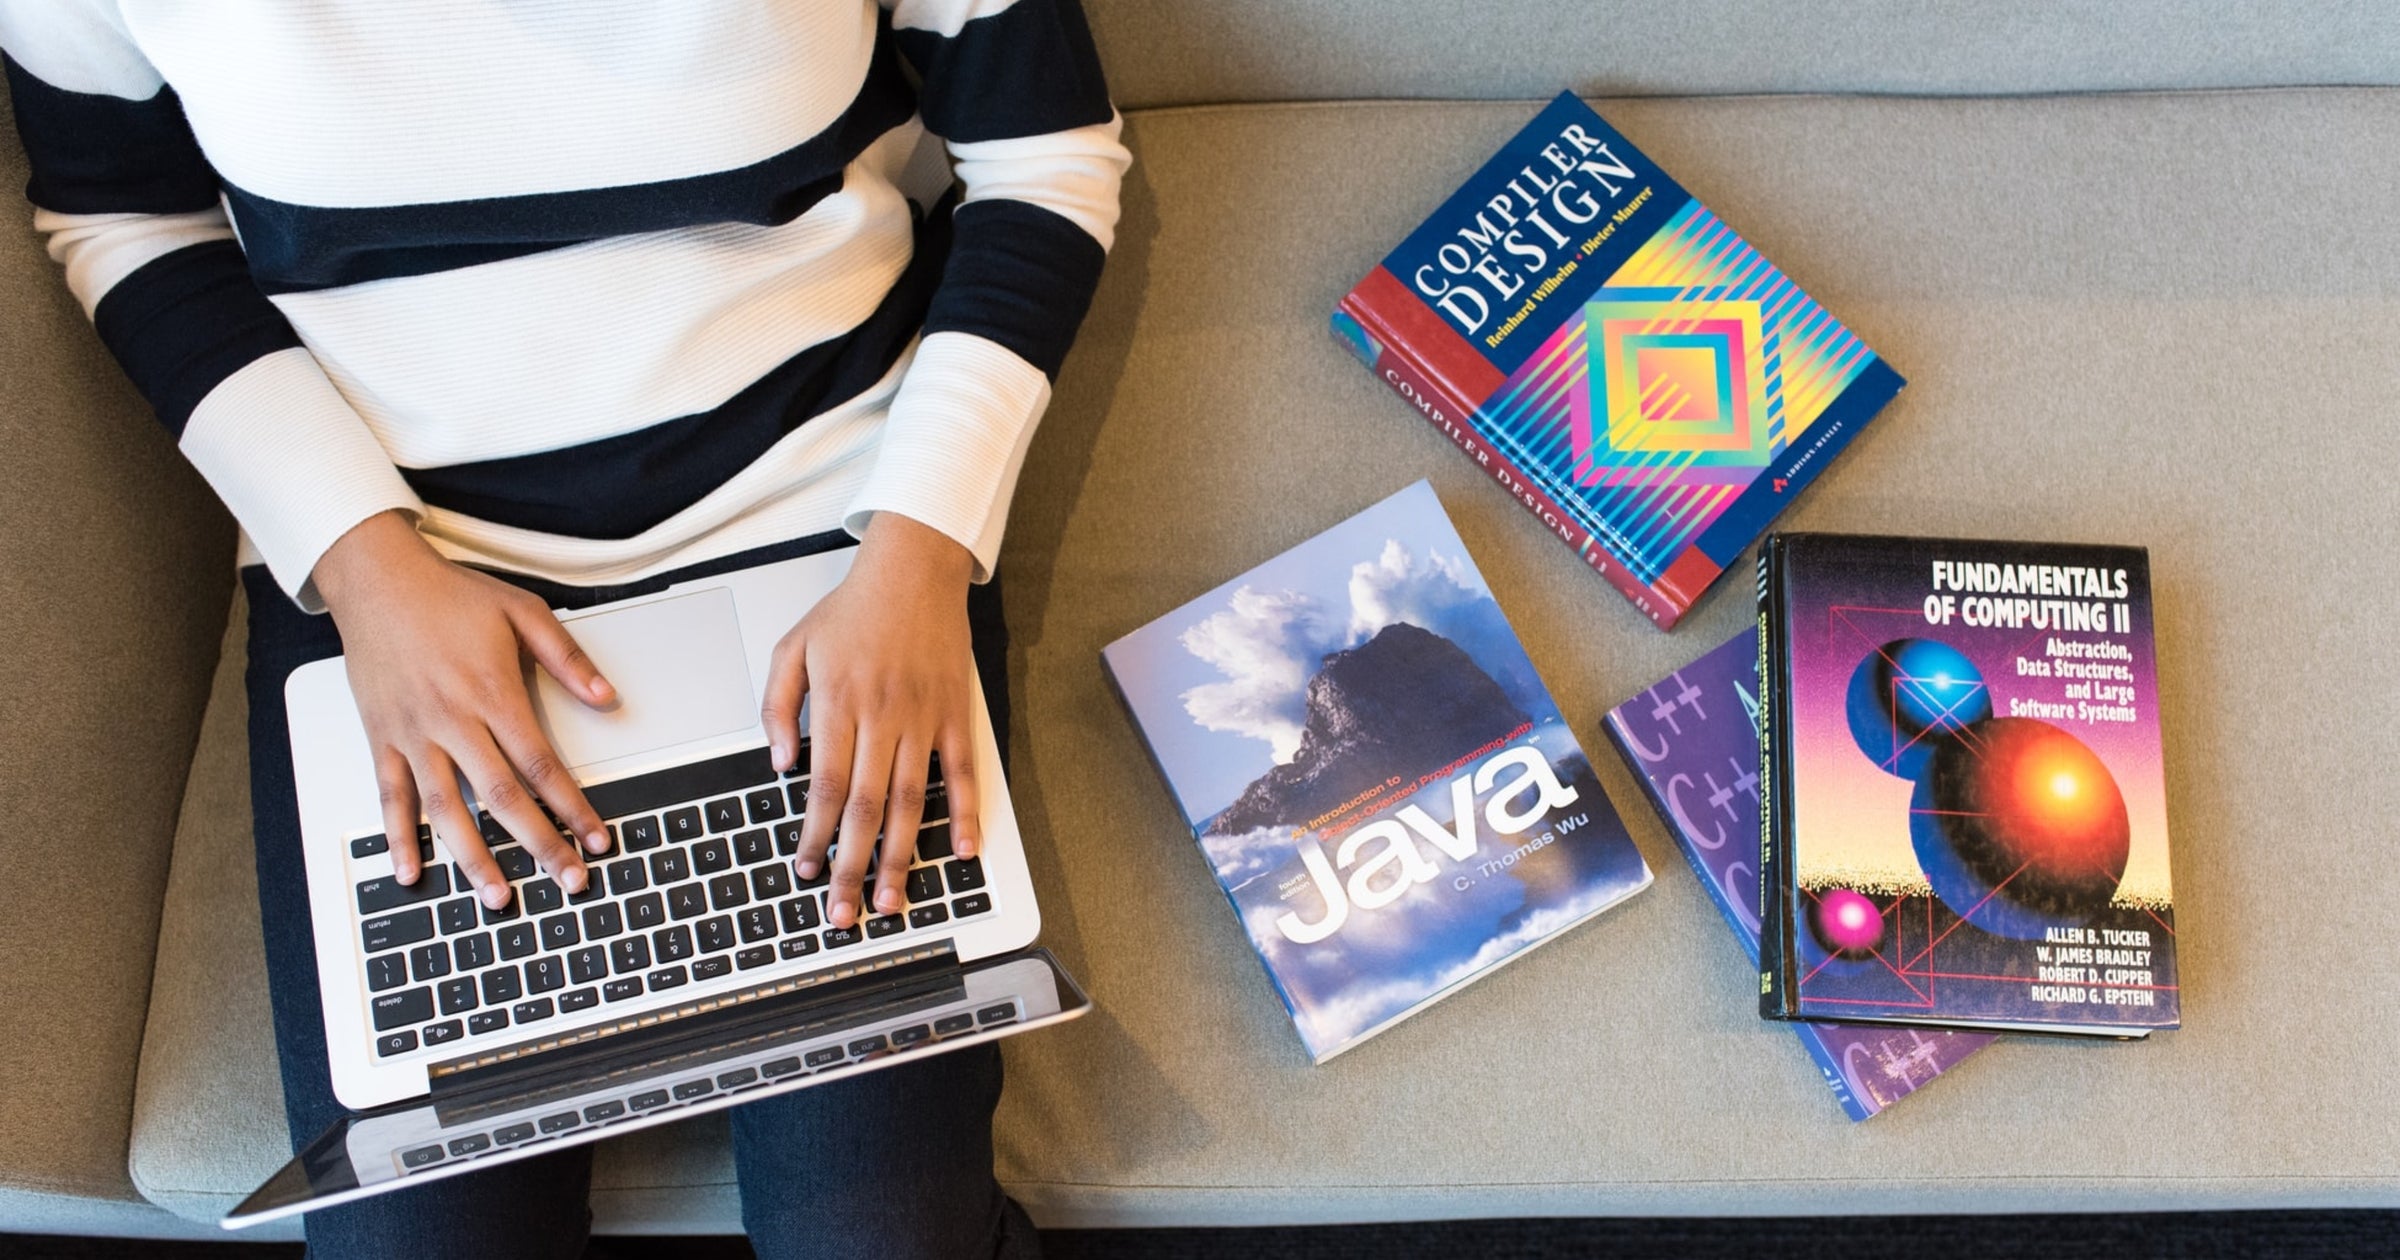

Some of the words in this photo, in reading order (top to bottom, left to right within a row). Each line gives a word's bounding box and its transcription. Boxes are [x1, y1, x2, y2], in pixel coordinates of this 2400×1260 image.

[1415, 123, 1600, 297] COMPILER
[1437, 143, 1636, 336] DESIGN
[1485, 298, 1536, 348] Reinhard
[1531, 260, 1578, 302] Wilhelm
[1580, 221, 1616, 256] Dieter
[1612, 186, 1654, 225] Maurer
[1385, 368, 1490, 467] COMPILER
[1496, 468, 1574, 542] DESIGN
[1932, 560, 2129, 599] FUNDAMENTALS
[1924, 594, 1956, 626] OF
[1961, 596, 2108, 632] COMPUTING
[2113, 603, 2131, 634] II
[2046, 638, 2133, 663] Abstraction,
[2017, 657, 2051, 677] Data
[2054, 659, 2134, 683] Structures,
[2065, 680, 2091, 700] and
[2094, 682, 2136, 705] Large
[1608, 671, 1708, 763] C++
[2010, 698, 2075, 719] Software
[2078, 701, 2137, 726] Systems
[1317, 782, 1418, 841] Object-Oriented
[1419, 737, 1506, 787] Programming
[1505, 721, 1534, 742] with
[761, 800, 770, 810] C
[1291, 826, 1308, 841] An
[1309, 783, 1386, 830] Introduction
[1387, 775, 1401, 787] to
[1667, 756, 1760, 850] C++
[721, 810, 729, 820] V
[679, 818, 687, 829] B
[636, 828, 646, 838] N
[789, 831, 798, 841] D
[750, 841, 756, 852] F
[1275, 744, 1579, 944] Java
[1477, 832, 1555, 879] Thomas
[1555, 812, 1589, 836] Wu
[706, 851, 716, 861] G
[664, 860, 674, 871] H
[624, 870, 630, 880] J
[766, 876, 775, 886] R
[1278, 872, 1306, 891] fourth
[364, 882, 380, 893] shift
[726, 886, 733, 896] T
[1280, 881, 1310, 900] edition
[539, 889, 546, 899] L
[683, 896, 691, 906] Y
[964, 900, 979, 909] esc
[640, 905, 650, 916] U
[795, 903, 802, 912] 4
[752, 912, 759, 923] 5
[797, 915, 805, 925] $
[368, 919, 392, 930] return
[710, 923, 717, 932] 6
[753, 925, 764, 935] %
[555, 925, 564, 936] O
[513, 935, 520, 946] P
[669, 932, 676, 942] 7
[2045, 926, 2085, 944] ALLEN
[2087, 928, 2100, 945] B.
[2102, 929, 2151, 947] TUCKER
[625, 942, 633, 952] 8
[670, 945, 678, 954] &
[583, 953, 590, 962] 9
[2036, 946, 2053, 962] W.
[2055, 946, 2093, 966] JAMES
[2096, 948, 2152, 967] BRADLEY
[539, 963, 547, 973] 0
[2039, 966, 2086, 983] ROBERT
[2089, 968, 2102, 984] D.
[2104, 969, 2153, 986] CUPPER
[2031, 985, 2086, 1003] RICHARD
[2089, 988, 2102, 1004] G.
[2104, 988, 2154, 1006] EPSTEIN
[378, 996, 403, 1007] delete
